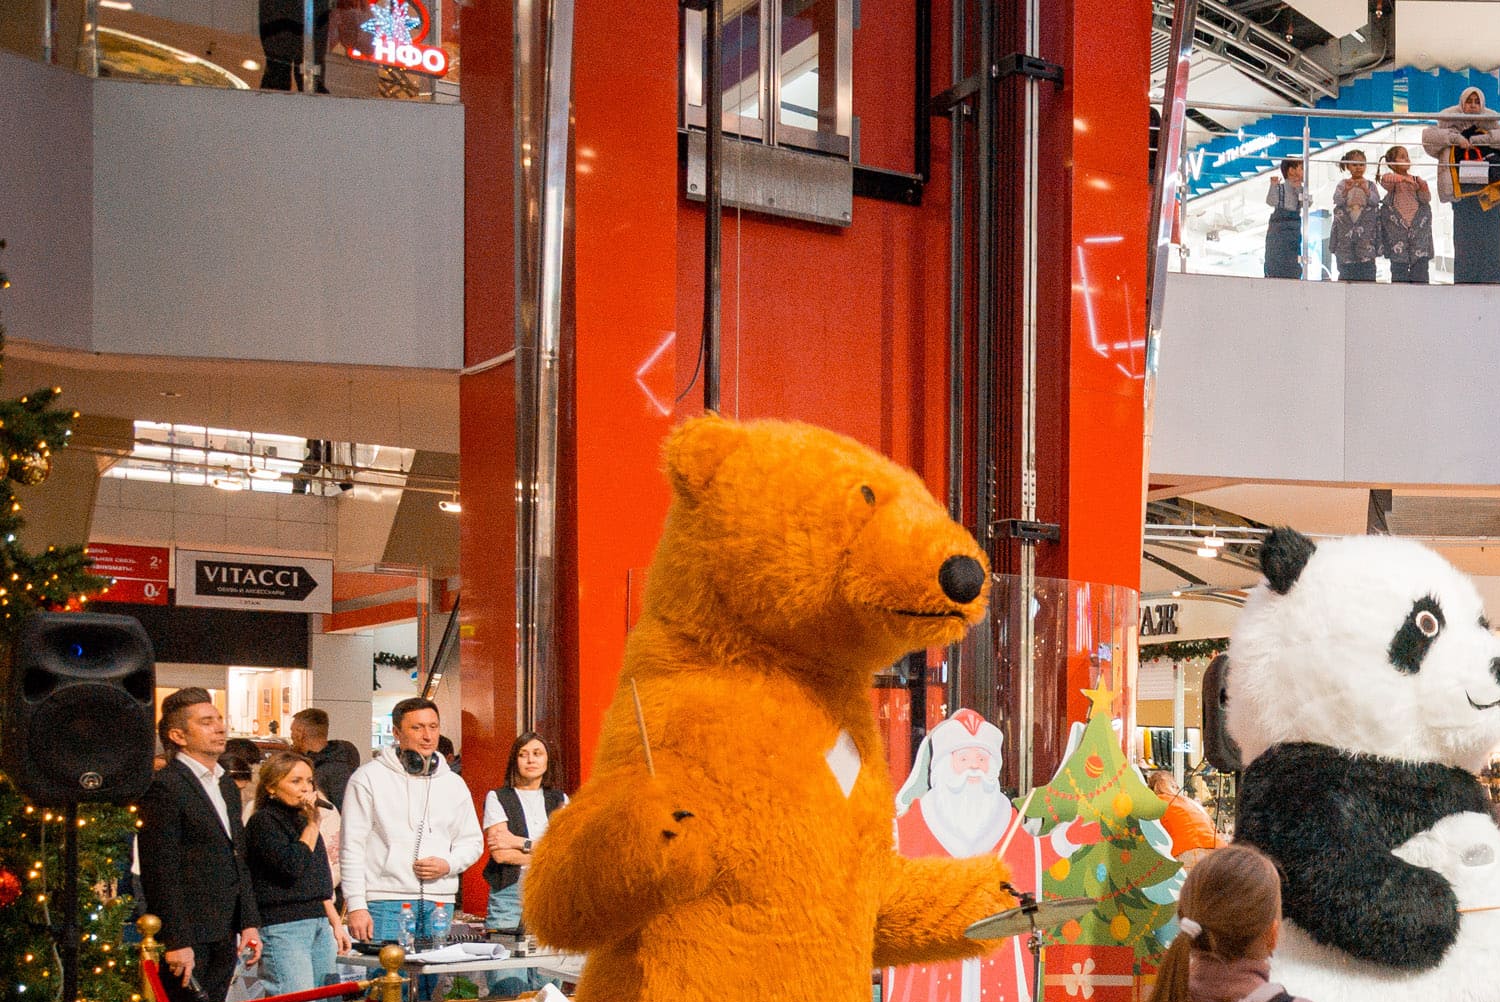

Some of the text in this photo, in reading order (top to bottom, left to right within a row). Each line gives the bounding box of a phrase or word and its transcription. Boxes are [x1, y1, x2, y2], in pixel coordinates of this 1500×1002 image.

[360, 40, 446, 72] НФО
[203, 565, 299, 587] VITACCI
[1140, 604, 1178, 636] АЖ
